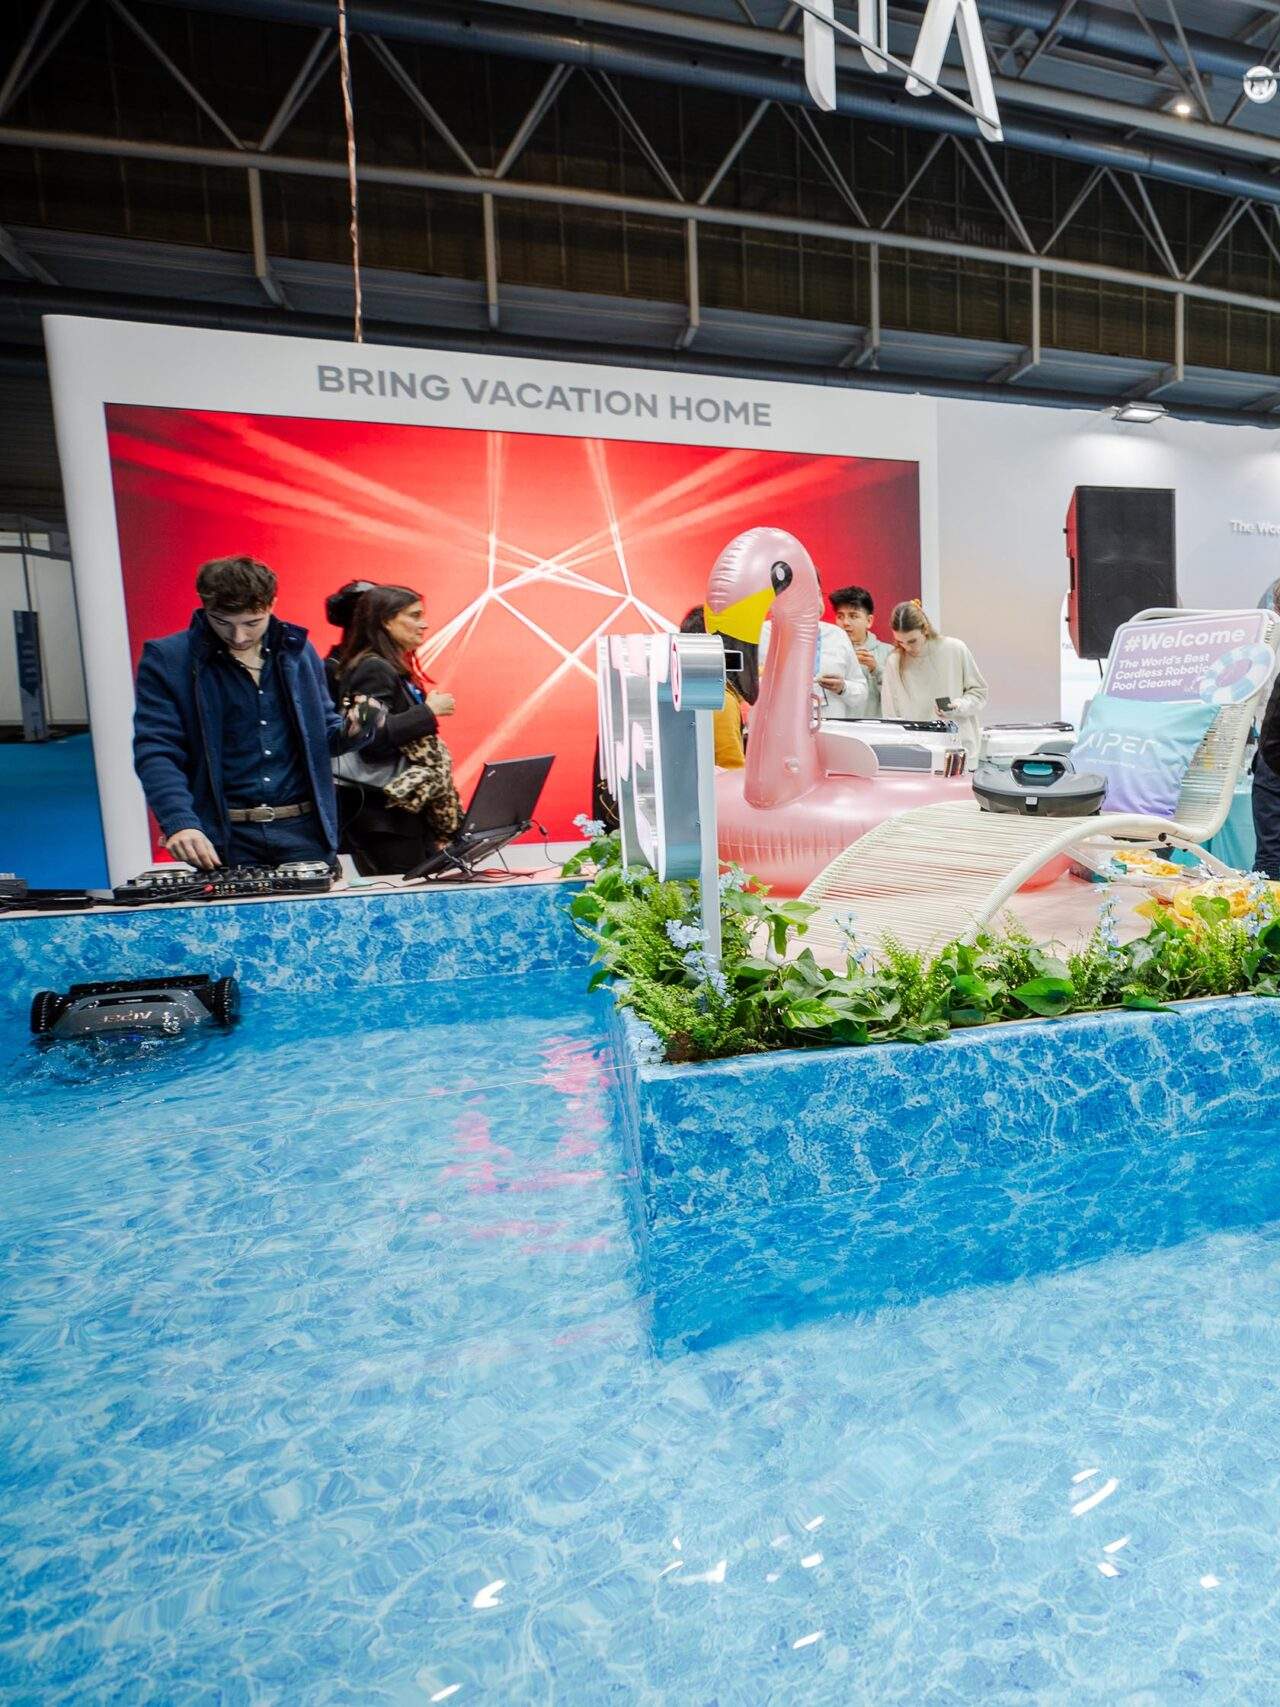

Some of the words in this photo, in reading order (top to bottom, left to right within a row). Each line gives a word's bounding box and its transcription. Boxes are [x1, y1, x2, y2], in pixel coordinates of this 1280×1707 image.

[317, 364, 451, 401] BRING
[461, 376, 659, 419] VACATION
[669, 395, 773, 427] HOME
[1230, 520, 1251, 535] The
[1124, 628, 1246, 653] #Welcome
[1119, 657, 1139, 669] The
[1141, 654, 1182, 668] World's
[1184, 652, 1211, 664] Best
[1115, 667, 1164, 681] Cordless
[1165, 663, 1210, 677] Robotic
[1111, 680, 1137, 693] Pool
[1137, 677, 1184, 691] Cleaner
